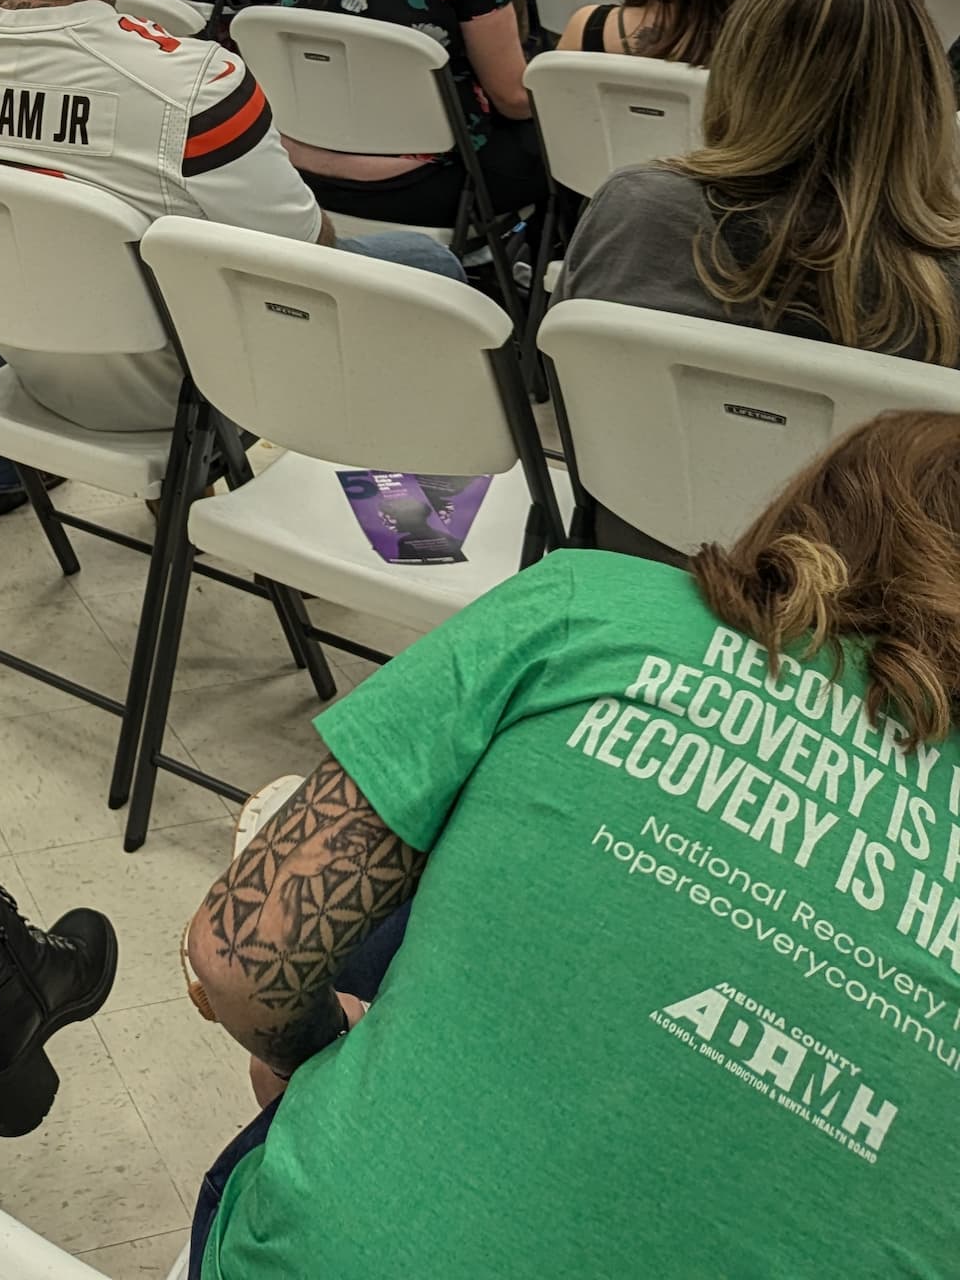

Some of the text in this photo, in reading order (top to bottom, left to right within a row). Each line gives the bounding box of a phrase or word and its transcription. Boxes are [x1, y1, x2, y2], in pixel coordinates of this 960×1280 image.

[53, 94, 91, 145] JR
[624, 654, 884, 818] RECOVERY
[885, 783, 936, 861] IS
[702, 625, 941, 792] RECOVERY
[565, 696, 840, 868] RECOVERY
[834, 827, 896, 911] IS
[640, 816, 947, 1019] National Recovery
[699, 1042, 726, 1066] DRUG
[724, 1058, 770, 1095] ADDICTION
[768, 1088, 777, 1101] &
[777, 1092, 811, 1120] MENTAL
[811, 1113, 848, 1145] HEALTH
[847, 1134, 878, 1165] BOARD
[715, 981, 863, 1078] MEDINA COUNTY
